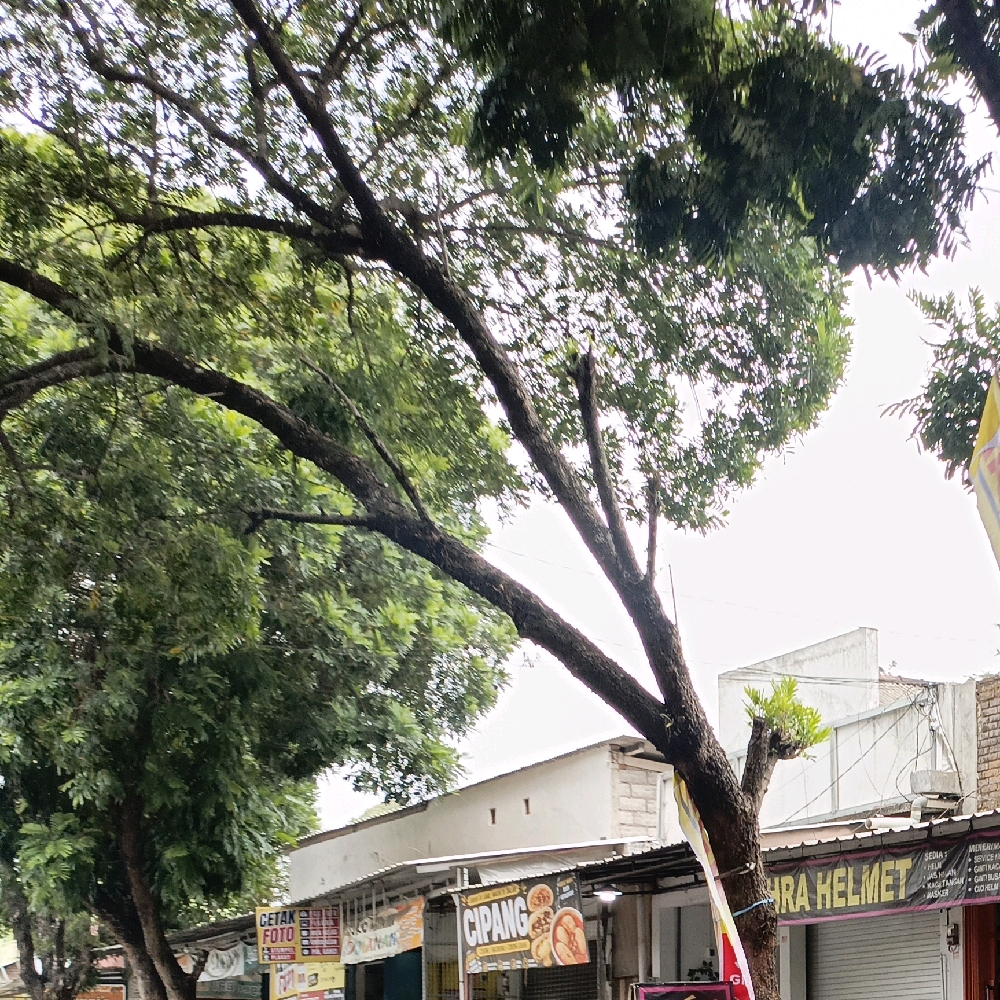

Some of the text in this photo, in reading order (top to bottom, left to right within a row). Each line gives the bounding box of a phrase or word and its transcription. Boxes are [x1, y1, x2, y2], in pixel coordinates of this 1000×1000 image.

[925, 851, 943, 861] SEDIA
[816, 858, 913, 910] HELMET
[260, 910, 295, 927] CETAK
[463, 896, 528, 946] CIPANG
[262, 926, 295, 945] FOTO
